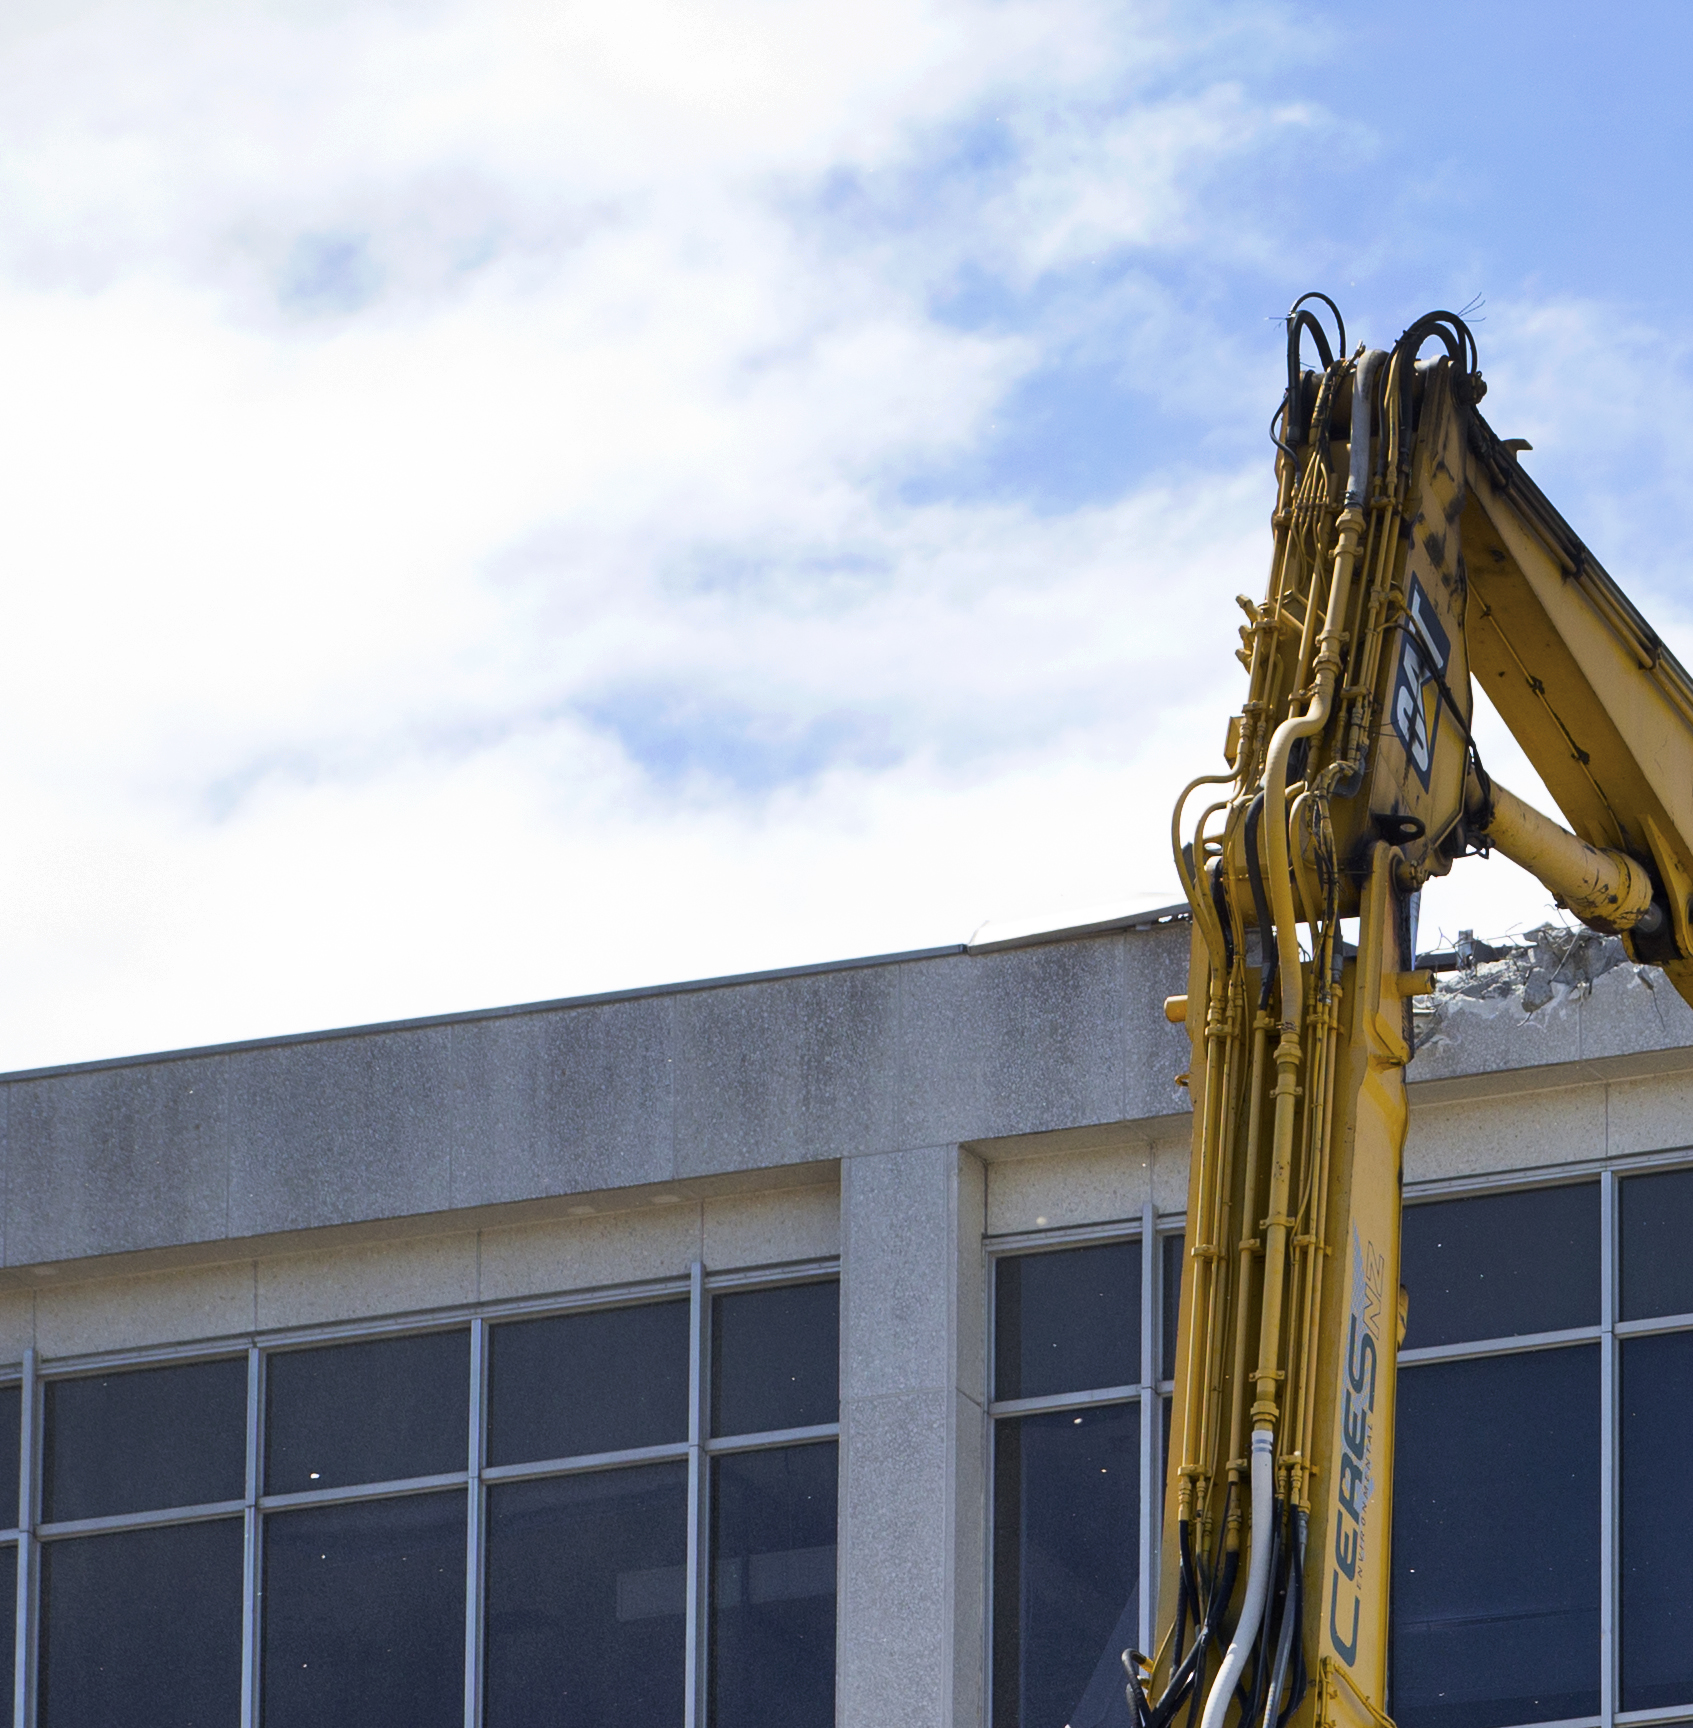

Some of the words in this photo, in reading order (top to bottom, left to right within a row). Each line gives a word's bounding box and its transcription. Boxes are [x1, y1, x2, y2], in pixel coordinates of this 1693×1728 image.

[1396, 583, 1444, 772] CAT
[1329, 1312, 1378, 1668] CERES
[1362, 1239, 1385, 1341] NZ
[1356, 1423, 1374, 1591] ENVIRONMENTAL
